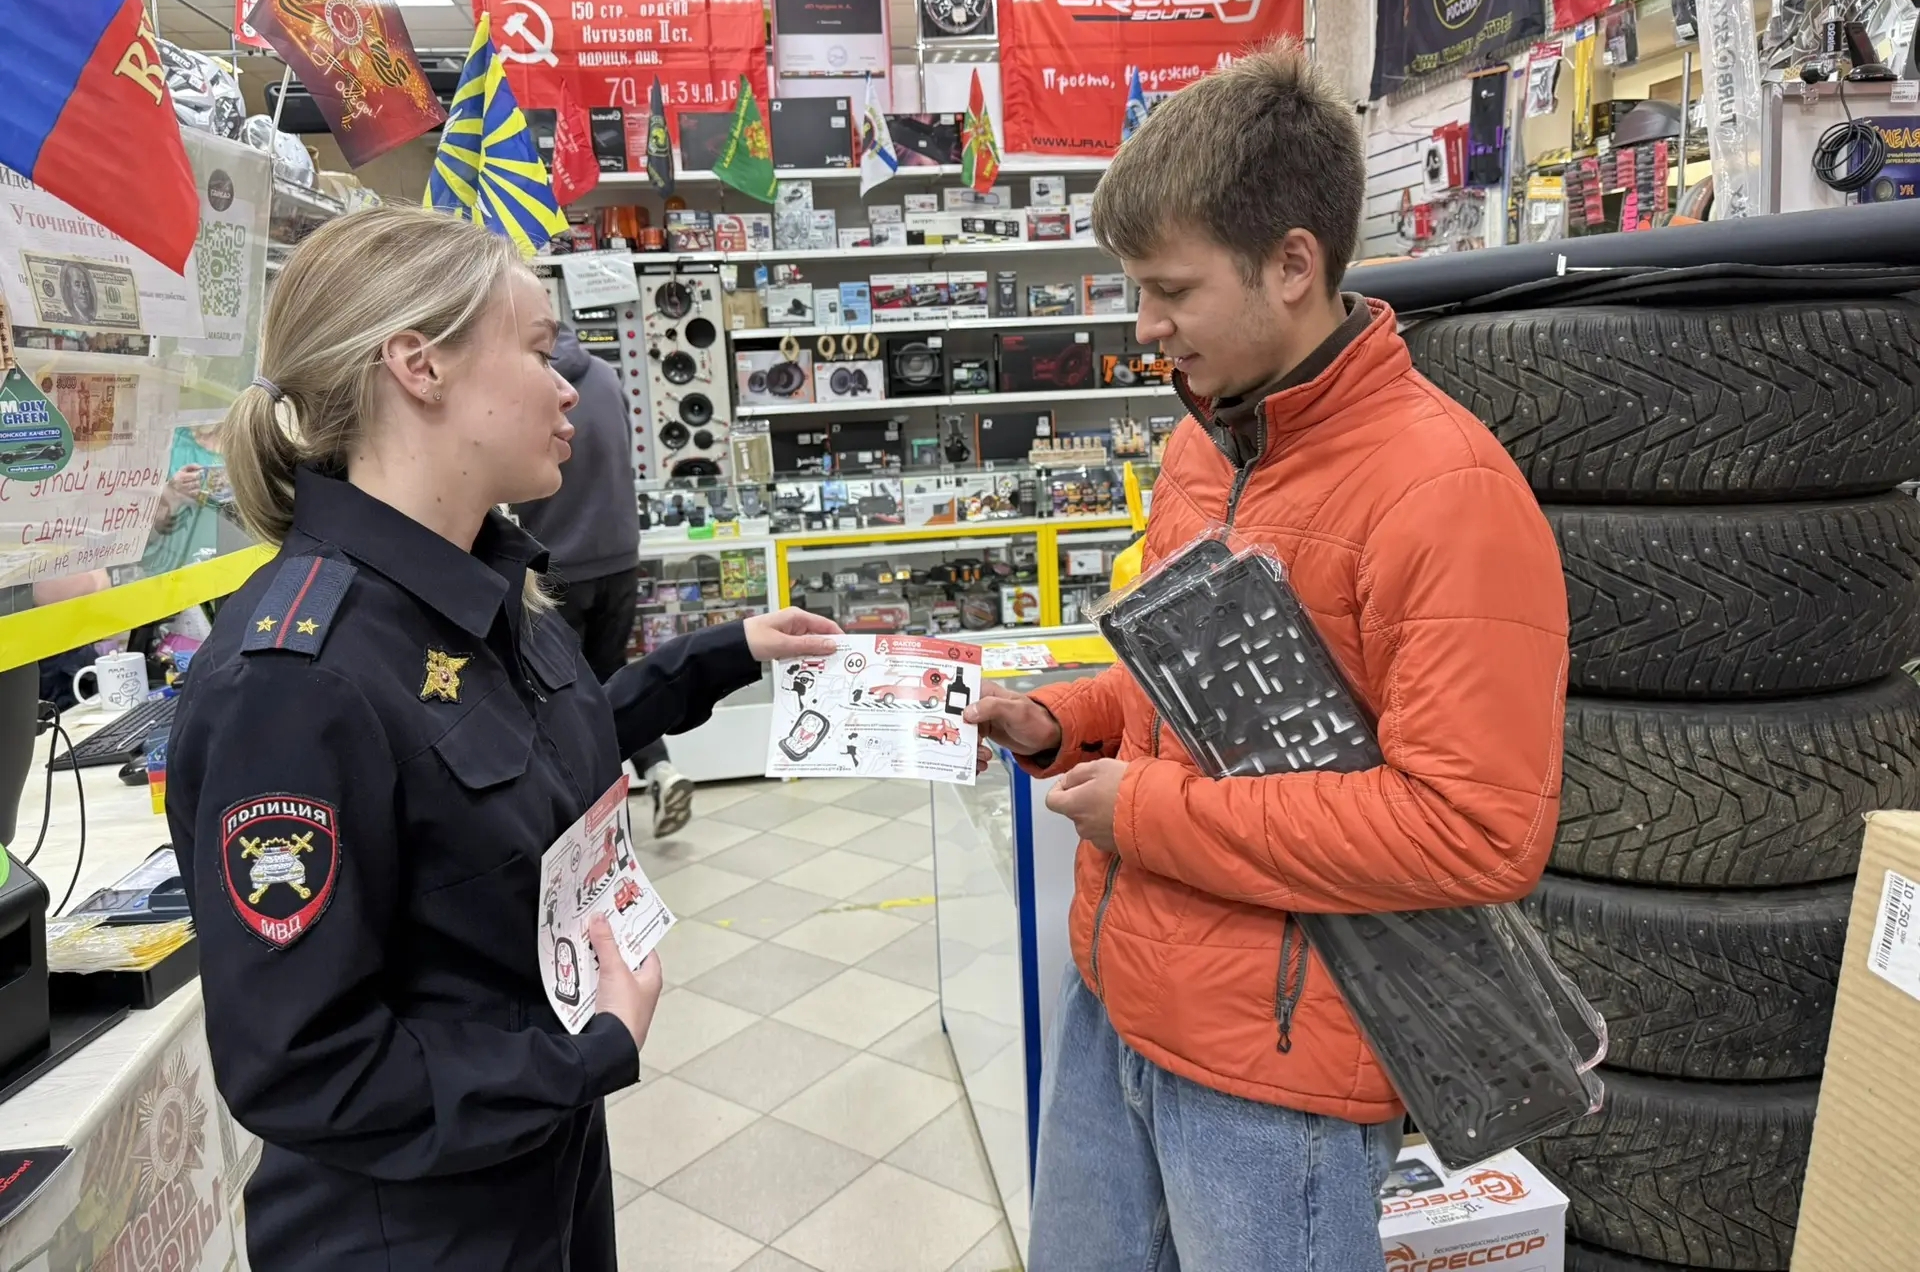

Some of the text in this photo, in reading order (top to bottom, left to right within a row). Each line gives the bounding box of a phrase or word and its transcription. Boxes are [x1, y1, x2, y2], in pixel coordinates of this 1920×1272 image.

[571, 2, 594, 20] 150
[1131, 8, 1206, 20] SOUND
[1042, 68, 1116, 95] Просто,
[9, 203, 105, 239] Уточняйте
[0, 400, 47, 413] MOLY
[3, 411, 49, 425] GREEN
[29, 429, 61, 437] КАЧЕСТВО
[847, 658, 863, 668] 60
[227, 801, 328, 833] ПОЛИЦИЯ
[259, 916, 303, 941] МВД
[1382, 1180, 1507, 1215] АГРЕССО
